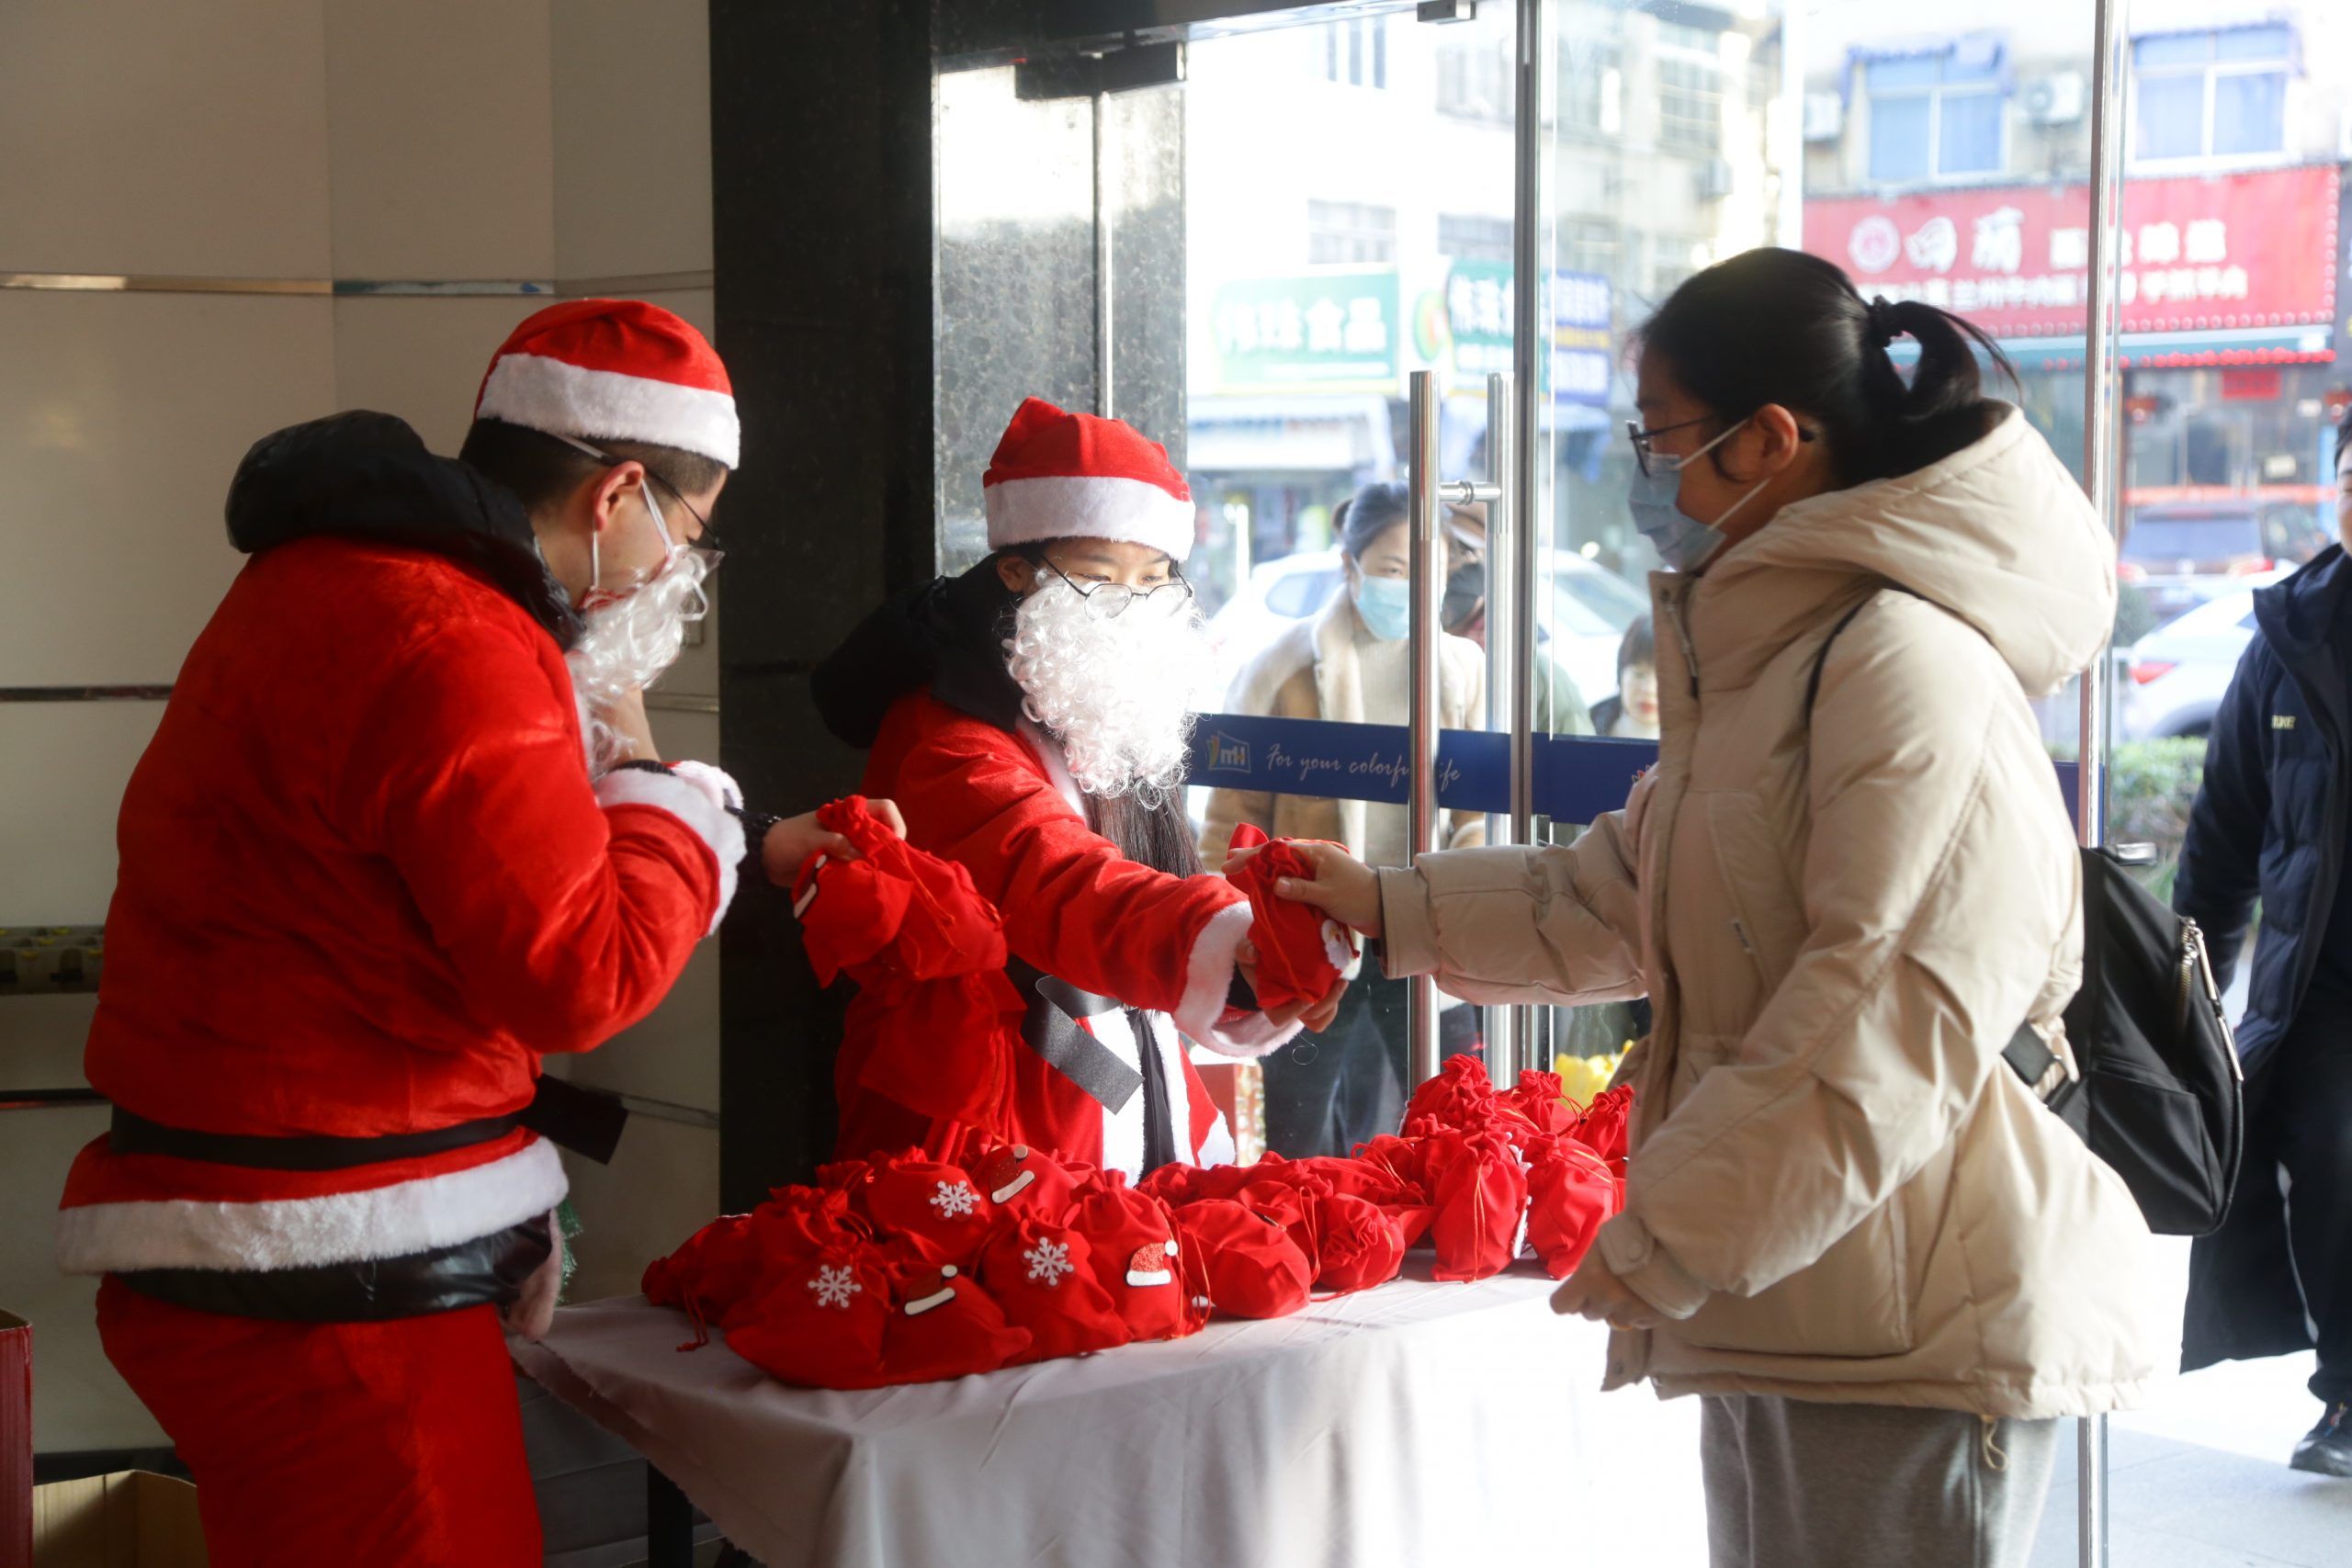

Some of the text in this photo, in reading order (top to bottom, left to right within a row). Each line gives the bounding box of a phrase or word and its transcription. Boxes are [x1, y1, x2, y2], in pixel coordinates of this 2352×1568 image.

[1266, 742, 1461, 793] For your colorfu ife
